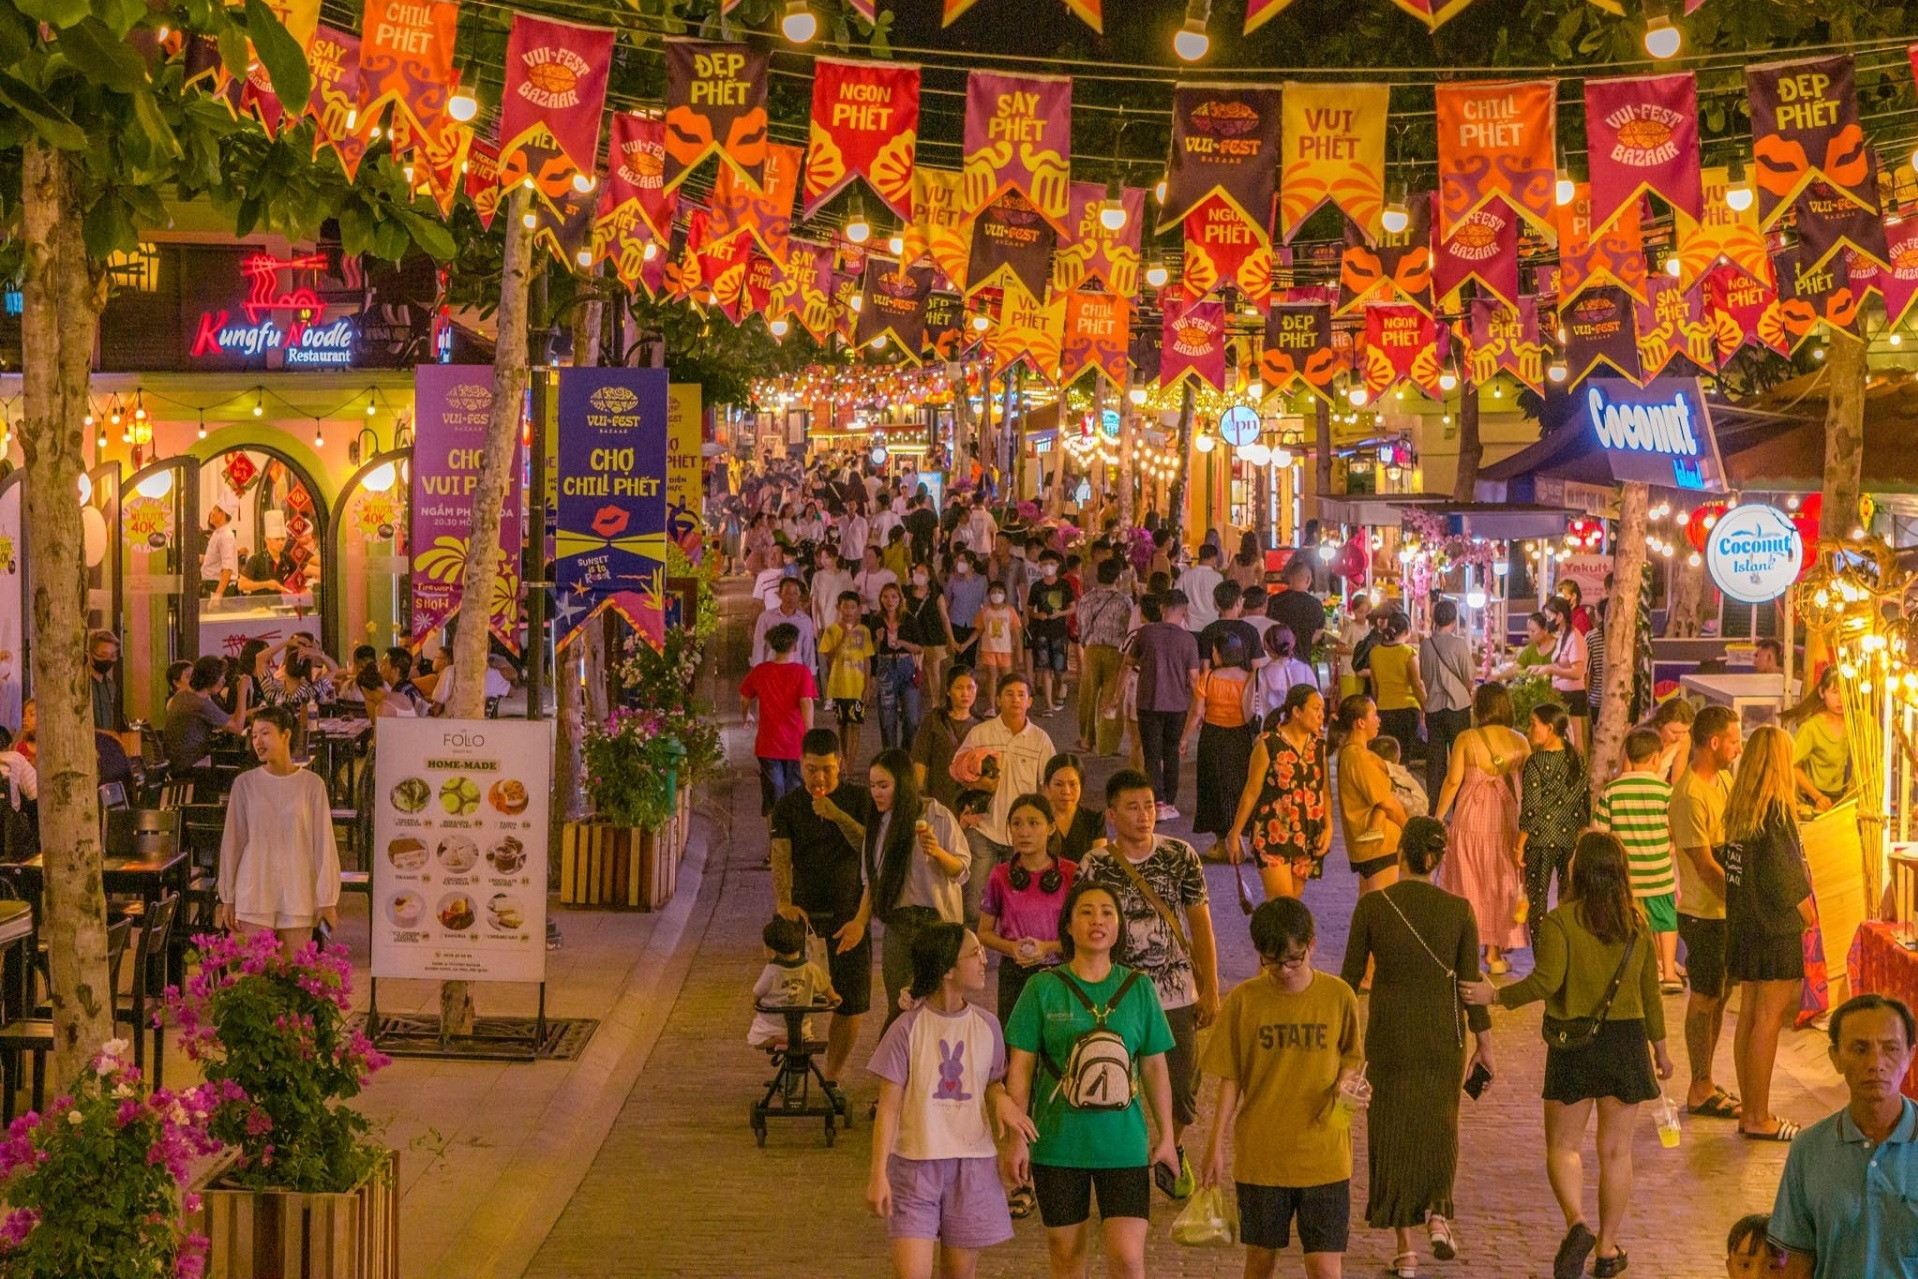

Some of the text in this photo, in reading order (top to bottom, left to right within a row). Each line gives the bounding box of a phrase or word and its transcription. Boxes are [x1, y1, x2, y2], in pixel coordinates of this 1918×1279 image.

[386, 2, 434, 27] CHILL
[314, 39, 347, 61] SAY
[375, 24, 434, 54] PHẾT
[521, 46, 591, 79] VUI-FEST
[694, 51, 745, 79] ĐẸP
[517, 80, 580, 109] BAZAAR
[691, 76, 751, 106] PHẾT
[839, 83, 891, 103] NGON
[1778, 73, 1831, 103] ĐẸP
[997, 90, 1041, 118] SAY
[1463, 95, 1521, 120] CHILL
[1776, 97, 1841, 131] PHẾT
[832, 102, 894, 131] PHẾT
[1305, 108, 1353, 133] VUI
[1605, 104, 1684, 131] VUI-FEST
[988, 114, 1048, 142] PHẾT
[1460, 119, 1525, 148] PHẾT
[621, 139, 665, 161] VUI-FES
[1185, 136, 1262, 156] VUI-FEST
[1298, 132, 1361, 160] PHẾT
[1610, 140, 1680, 167] BAZAAR
[921, 184, 956, 207] VUI
[983, 223, 1041, 242] VUI-FEST
[790, 251, 815, 268] SAY
[1449, 241, 1501, 261] BAZAAR
[873, 294, 918, 312] VUI-FEST
[1656, 290, 1683, 305] SAY
[1081, 302, 1114, 317] CHILL
[190, 310, 352, 357] Kungfu Noodle
[1171, 316, 1217, 335] VUI-FEST
[1281, 315, 1315, 331] ĐẸP
[1383, 317, 1417, 329] NGON
[1574, 322, 1620, 336] VUI-FEST
[288, 348, 351, 363] Restaurant
[1172, 340, 1214, 357] BAZAAR
[442, 413, 490, 425] VUI-FES
[587, 415, 641, 427] VUI-FEST
[1588, 386, 1697, 456] Coconut
[590, 447, 636, 476] CHỢ
[421, 476, 460, 496] VUI
[563, 474, 610, 496] CHILL
[614, 476, 661, 497] PHẾT
[131, 521, 156, 533] 40K
[363, 513, 386, 524] 40K
[1719, 535, 1790, 556] Coconut
[577, 555, 609, 567] SUNSET
[1565, 563, 1608, 573] Yakult
[416, 598, 449, 610] SHOW
[428, 760, 497, 771] HOME-MADE
[1258, 1022, 1328, 1052] STATE
